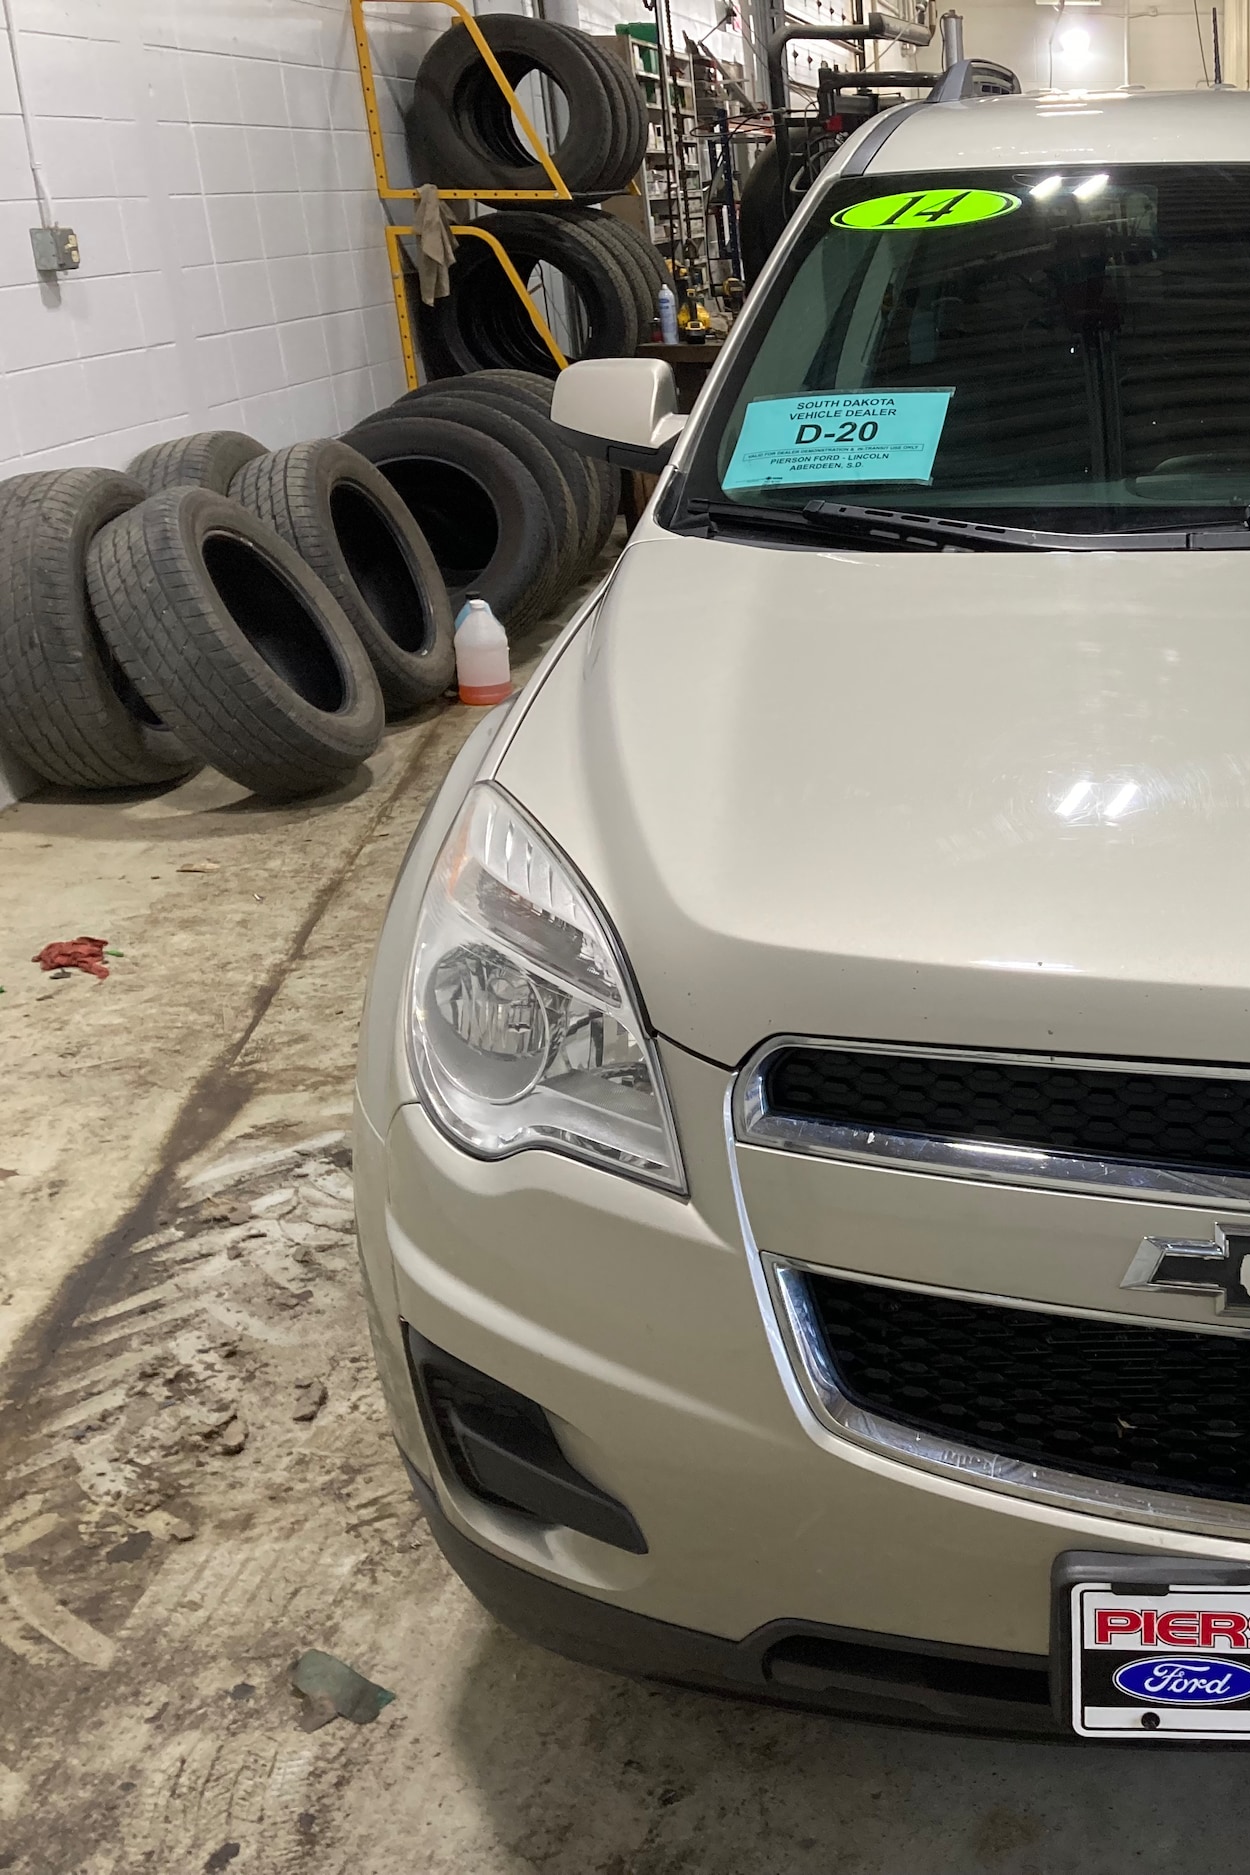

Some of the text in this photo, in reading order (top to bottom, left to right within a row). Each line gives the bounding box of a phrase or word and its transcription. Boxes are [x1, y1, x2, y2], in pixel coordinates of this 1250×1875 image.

[872, 190, 973, 227] 14
[797, 398, 895, 410] SOUTH DAKOTA
[789, 408, 897, 420] VEHICLE DEALER
[795, 421, 878, 445] D-20
[770, 456, 811, 465] PIERSON
[814, 454, 840, 462] FORD
[848, 453, 889, 461] LINCOLN
[789, 461, 864, 472] ABERDEEN, S.D.
[1144, 1663, 1232, 1694] Ford
